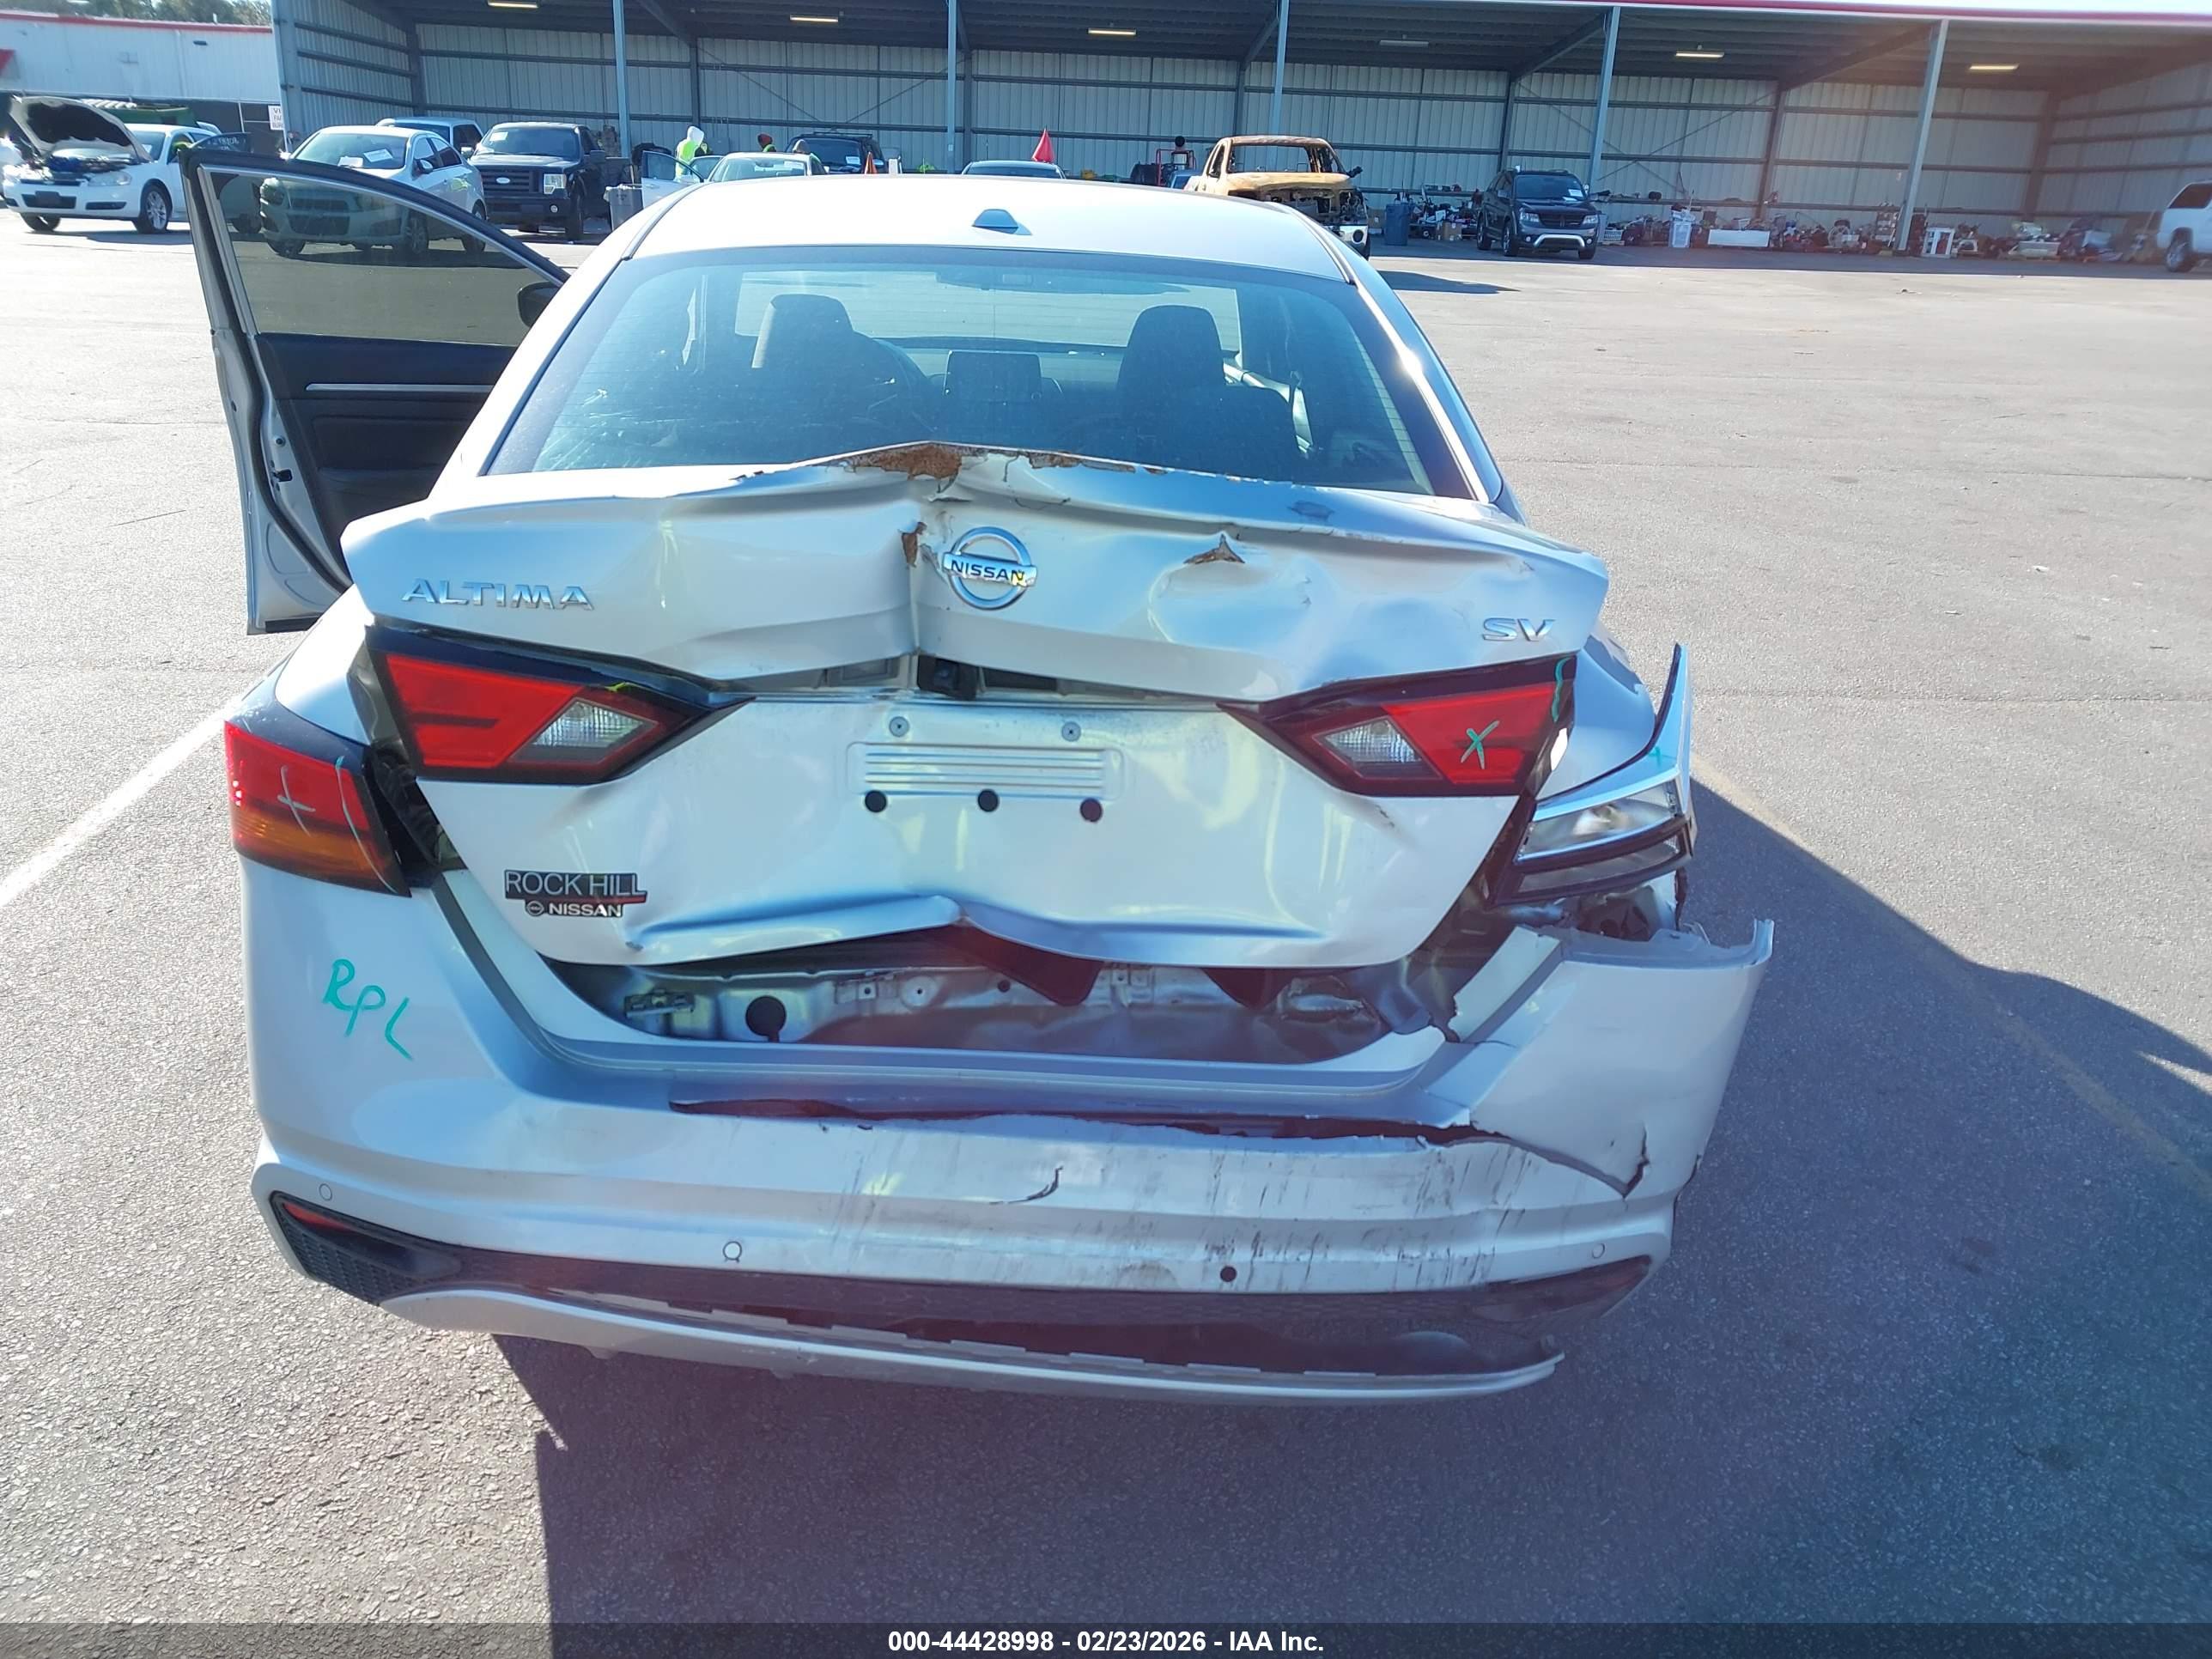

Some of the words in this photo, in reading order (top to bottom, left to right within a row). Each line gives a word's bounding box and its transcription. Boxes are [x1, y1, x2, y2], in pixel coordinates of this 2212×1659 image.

[951, 559, 1025, 582] NISSAN
[401, 577, 594, 611] ALTIMA
[1482, 617, 1555, 642] SV
[505, 871, 583, 896] ROCK
[589, 873, 646, 896] HILL
[549, 902, 622, 917] NISSAN
